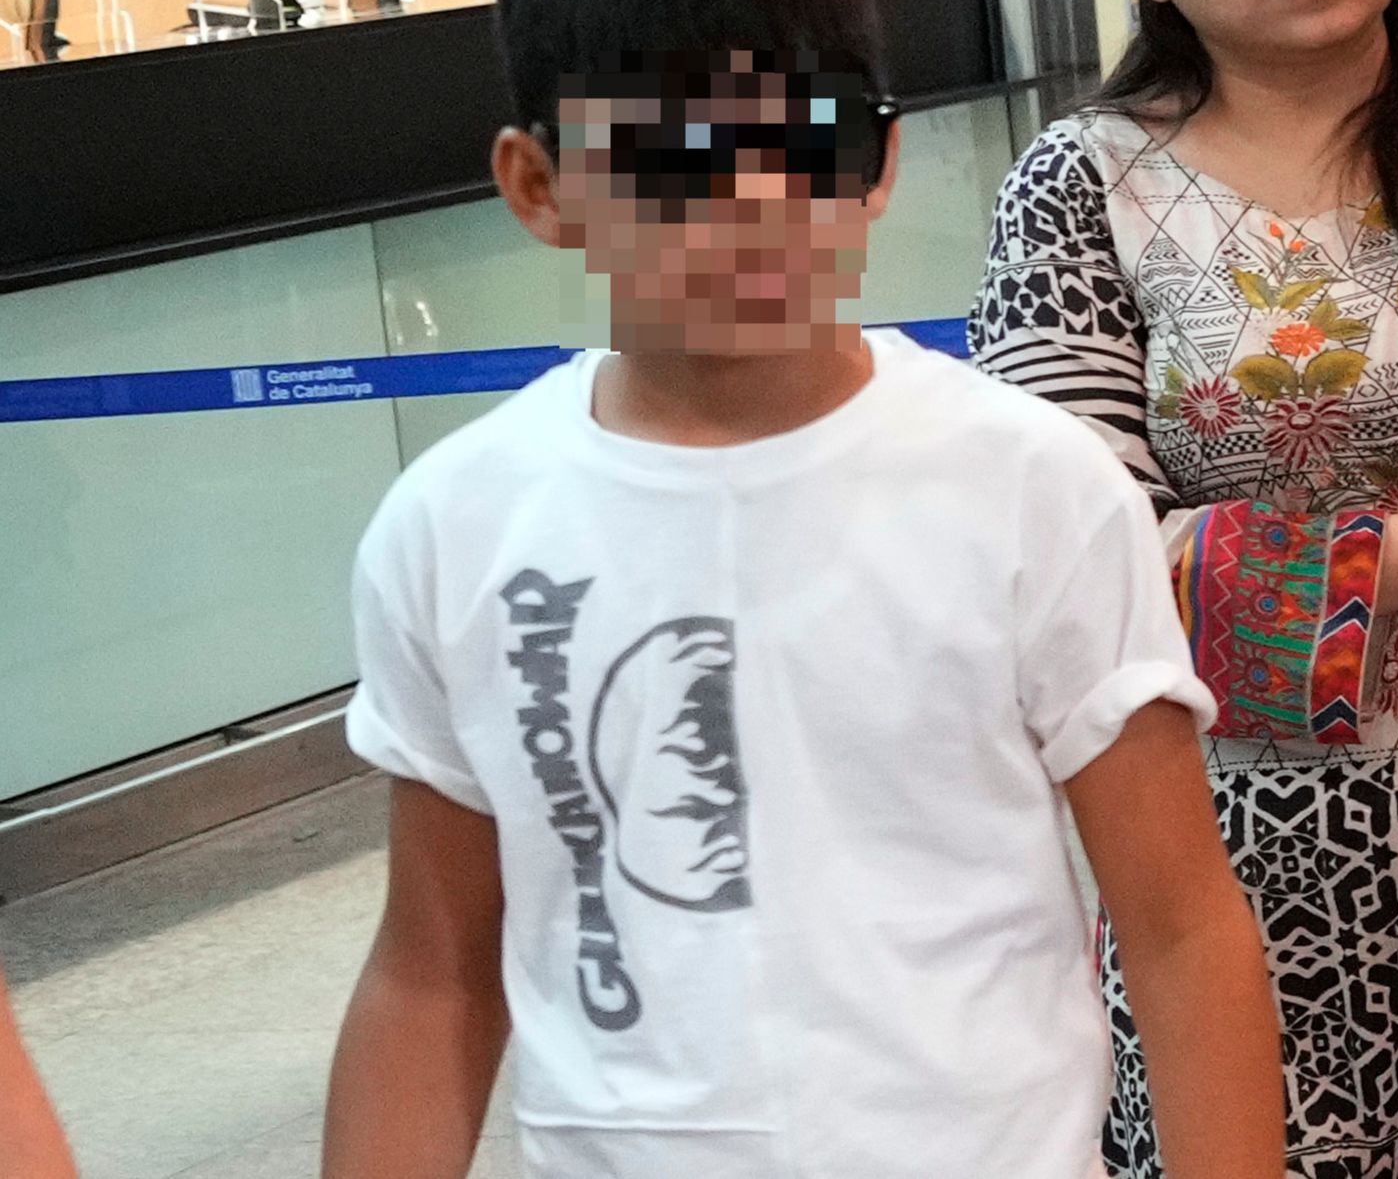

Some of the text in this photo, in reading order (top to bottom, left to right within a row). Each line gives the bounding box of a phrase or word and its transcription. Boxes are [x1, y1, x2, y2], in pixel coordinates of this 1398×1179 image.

[267, 366, 355, 384] Generalitat
[269, 382, 373, 400] de Catalunya
